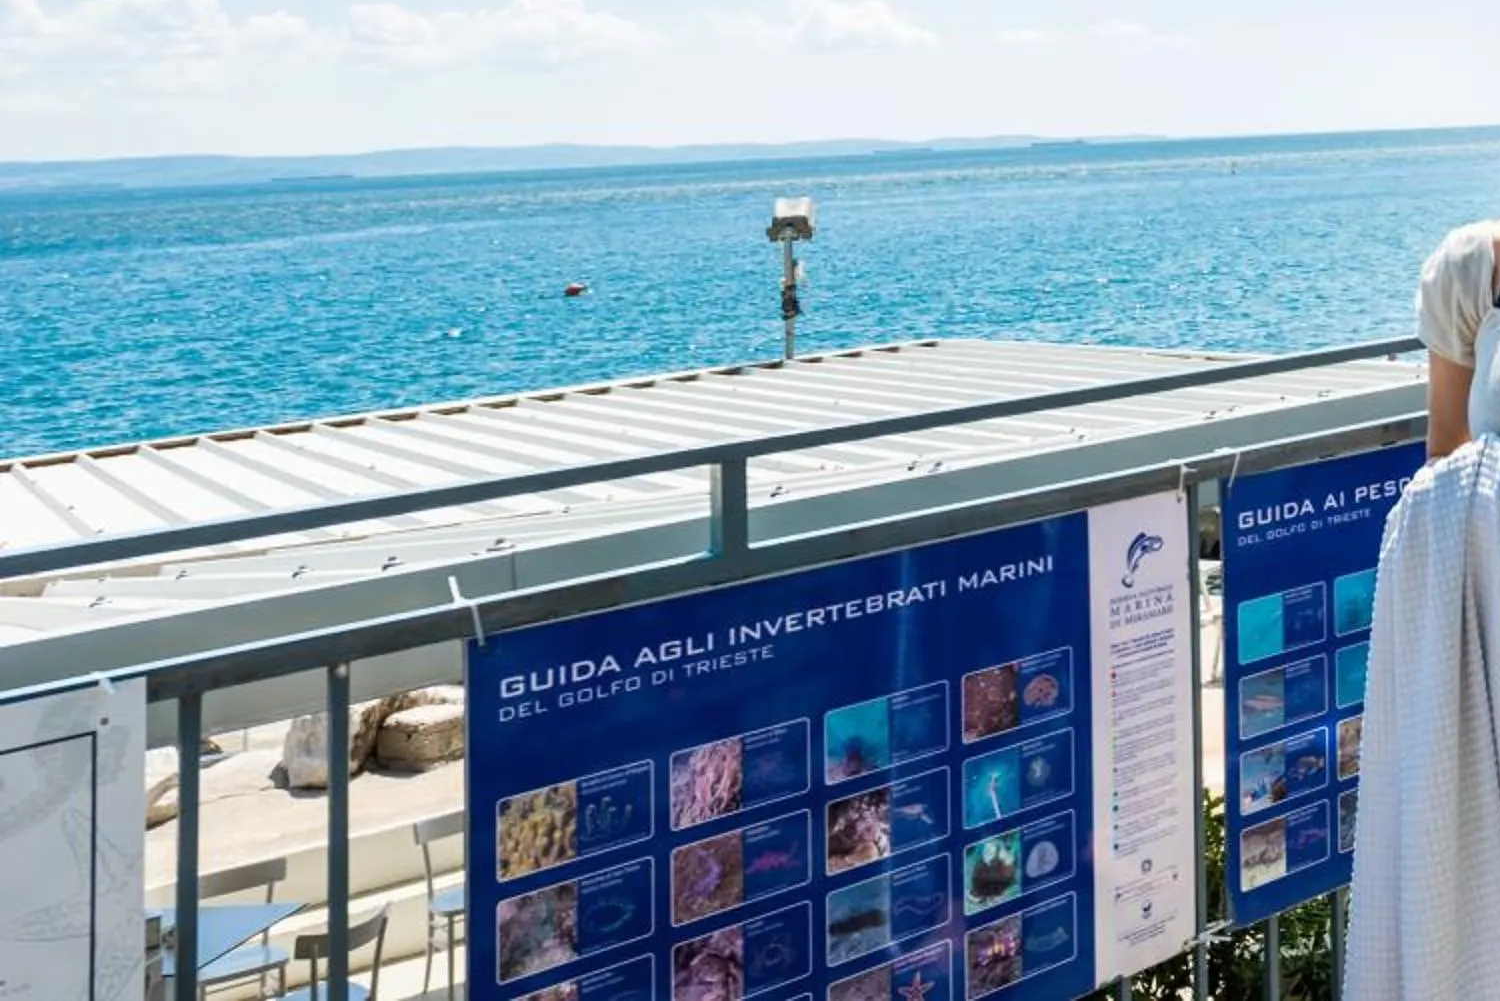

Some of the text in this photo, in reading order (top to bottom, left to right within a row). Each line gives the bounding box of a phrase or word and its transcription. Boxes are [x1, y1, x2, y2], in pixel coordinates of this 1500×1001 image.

[1237, 507, 1371, 547] DEL GOLFO DI TRIESTE
[1238, 499, 1315, 529] GUIDA
[1323, 490, 1345, 510] AI
[1109, 592, 1174, 617] MARINA
[500, 554, 1054, 699] GUIDA AGLI INVERTEBRATI MARINI
[499, 643, 775, 722] DEL GOLFO DI TRIESTE
